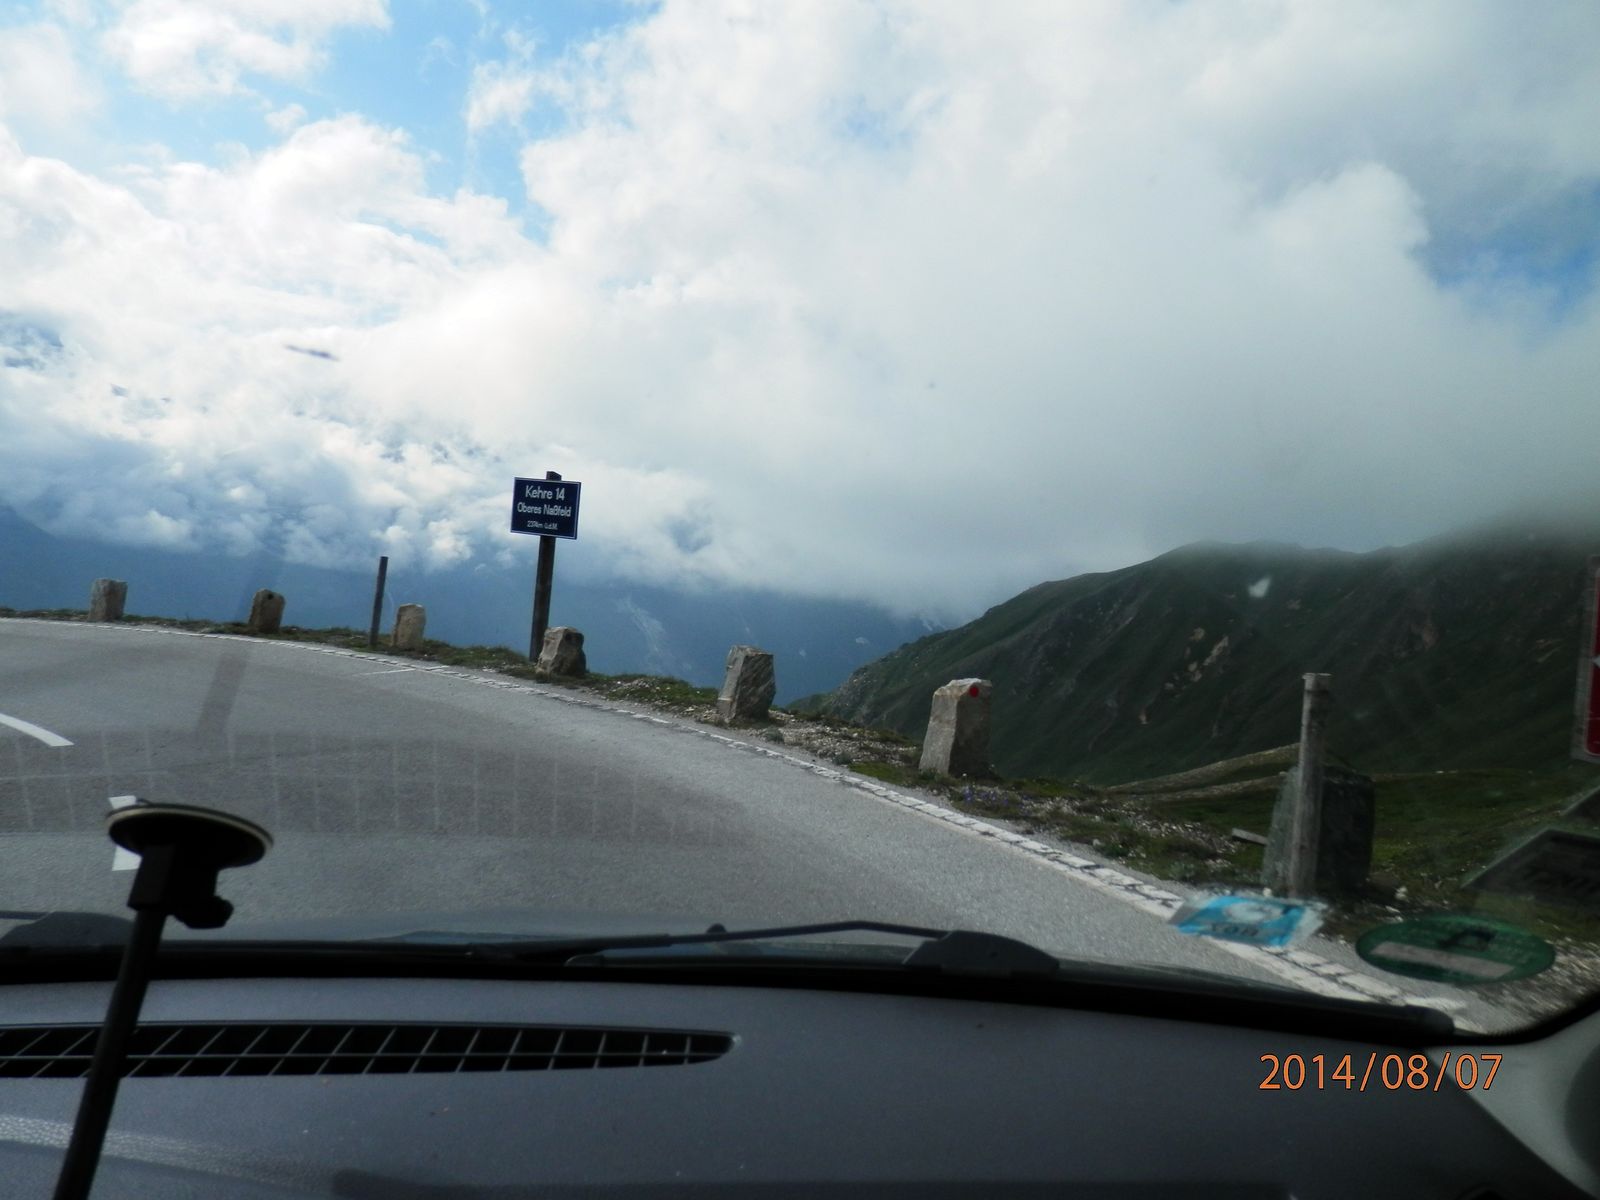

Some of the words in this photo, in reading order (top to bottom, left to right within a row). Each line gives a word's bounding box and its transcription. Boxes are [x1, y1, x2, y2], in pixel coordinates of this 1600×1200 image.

[525, 485, 553, 500] Kehre
[555, 487, 565, 500] 14
[517, 502, 541, 514] Oberes
[543, 504, 572, 517] Naßfeld
